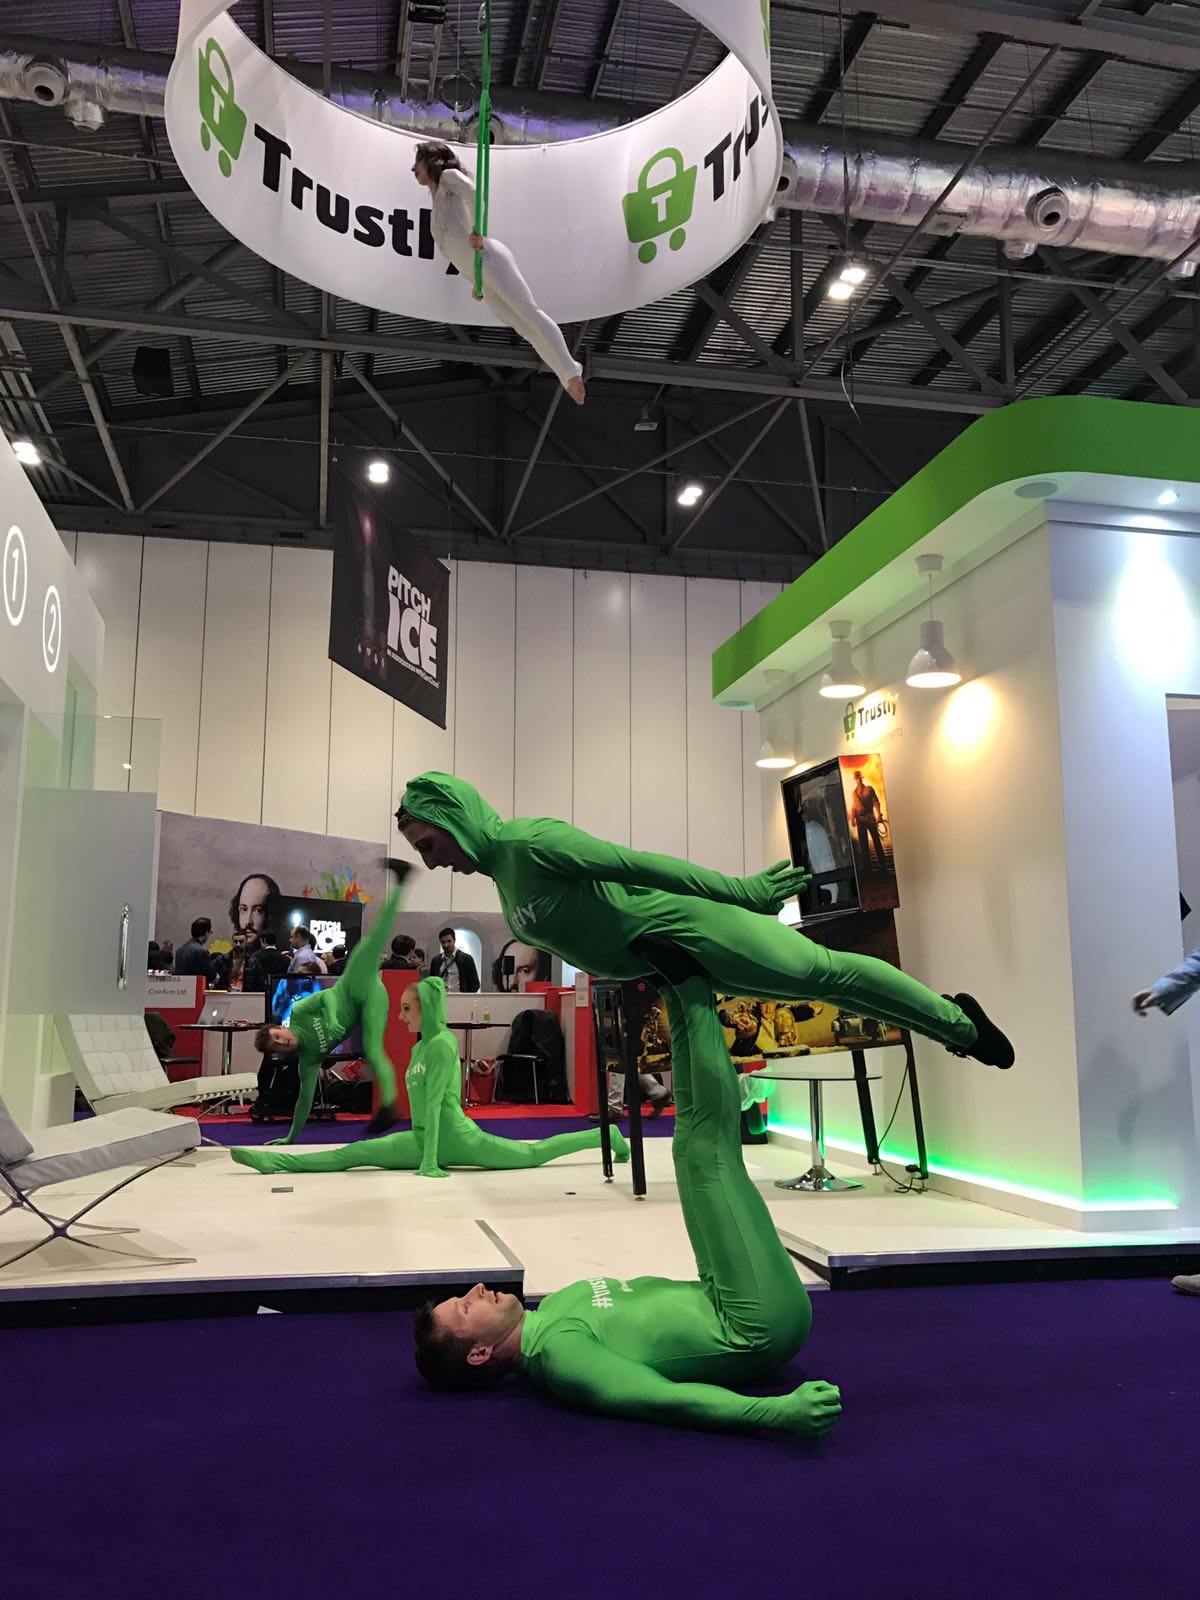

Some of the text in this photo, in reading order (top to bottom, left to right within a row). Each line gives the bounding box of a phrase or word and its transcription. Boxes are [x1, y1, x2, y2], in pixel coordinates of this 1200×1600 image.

[253, 122, 460, 275] Trustl
[387, 564, 431, 623] PITCH
[386, 591, 438, 679] ICE
[857, 693, 898, 727] Trustly
[177, 987, 187, 995] Ltd
